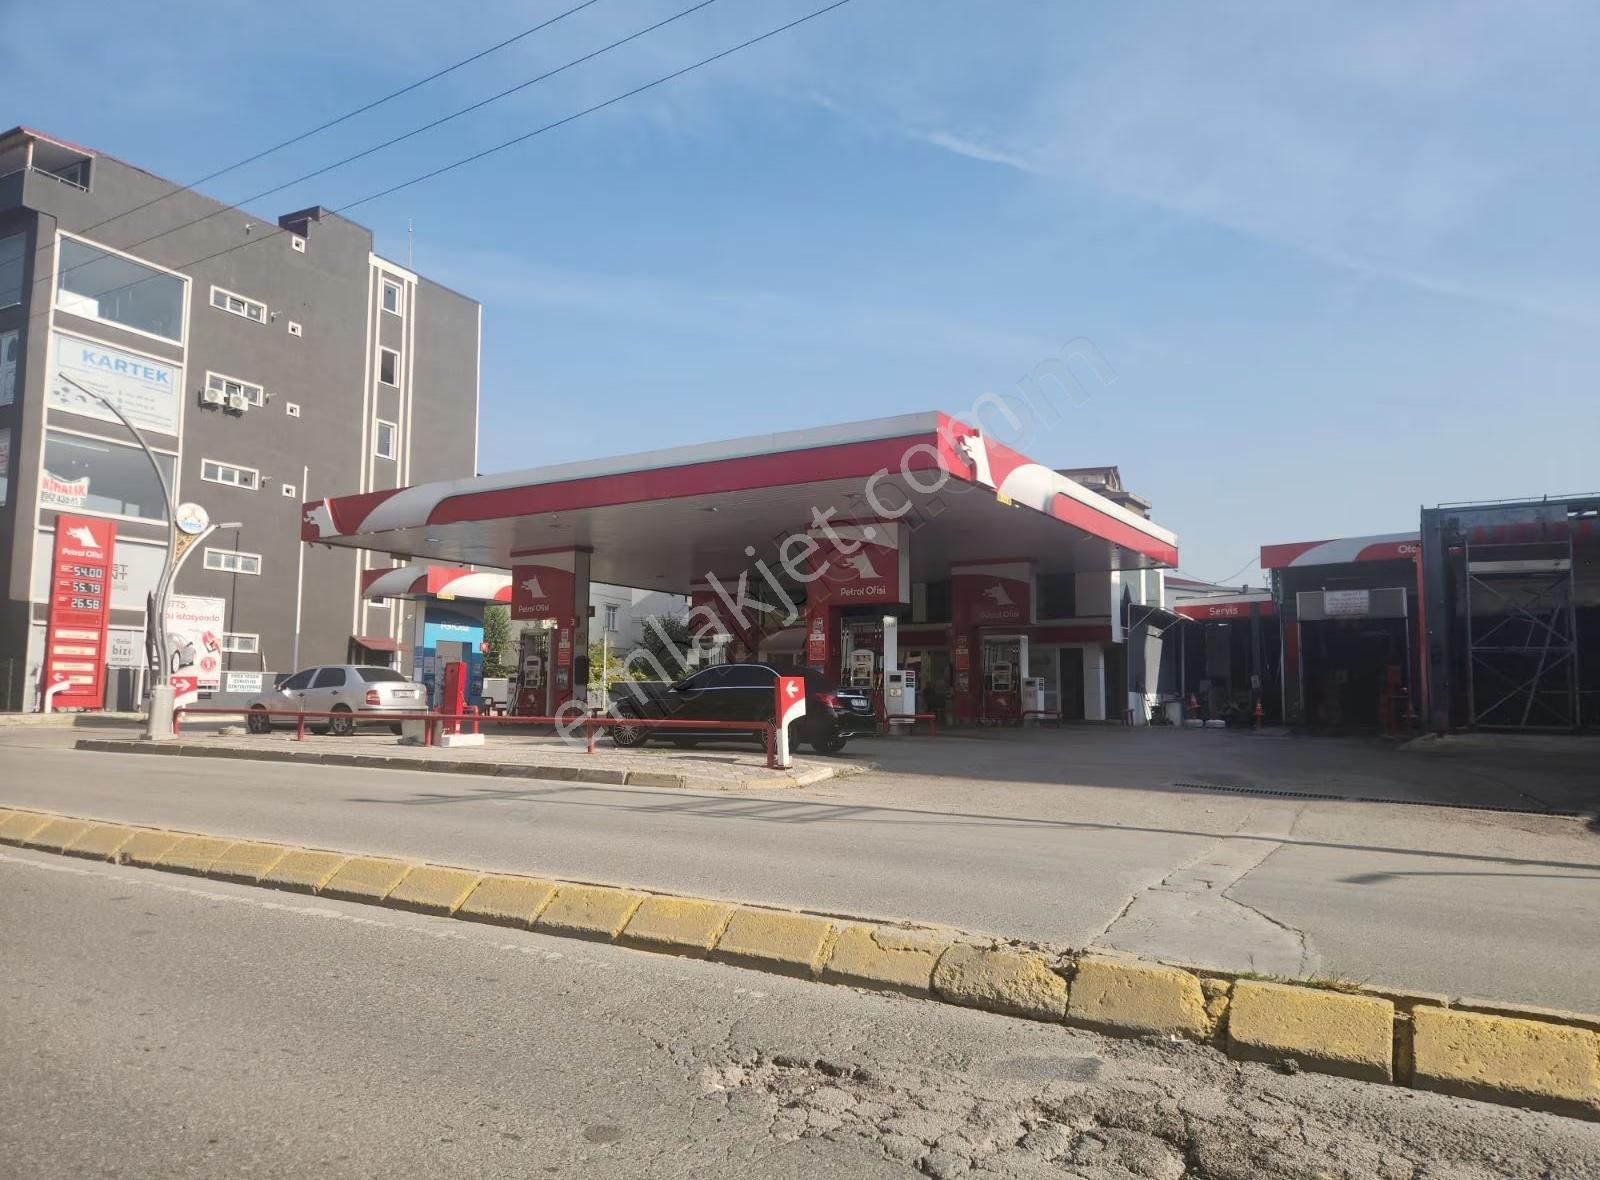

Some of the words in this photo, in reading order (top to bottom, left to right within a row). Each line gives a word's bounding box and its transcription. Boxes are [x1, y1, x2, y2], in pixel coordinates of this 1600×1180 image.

[82, 350, 169, 384] KARTEK
[72, 582, 101, 594] 55.79
[840, 587, 865, 597] Petrol
[866, 585, 886, 595] Ofisi
[71, 598, 100, 609] 26.58
[1208, 607, 1240, 616] Servis
